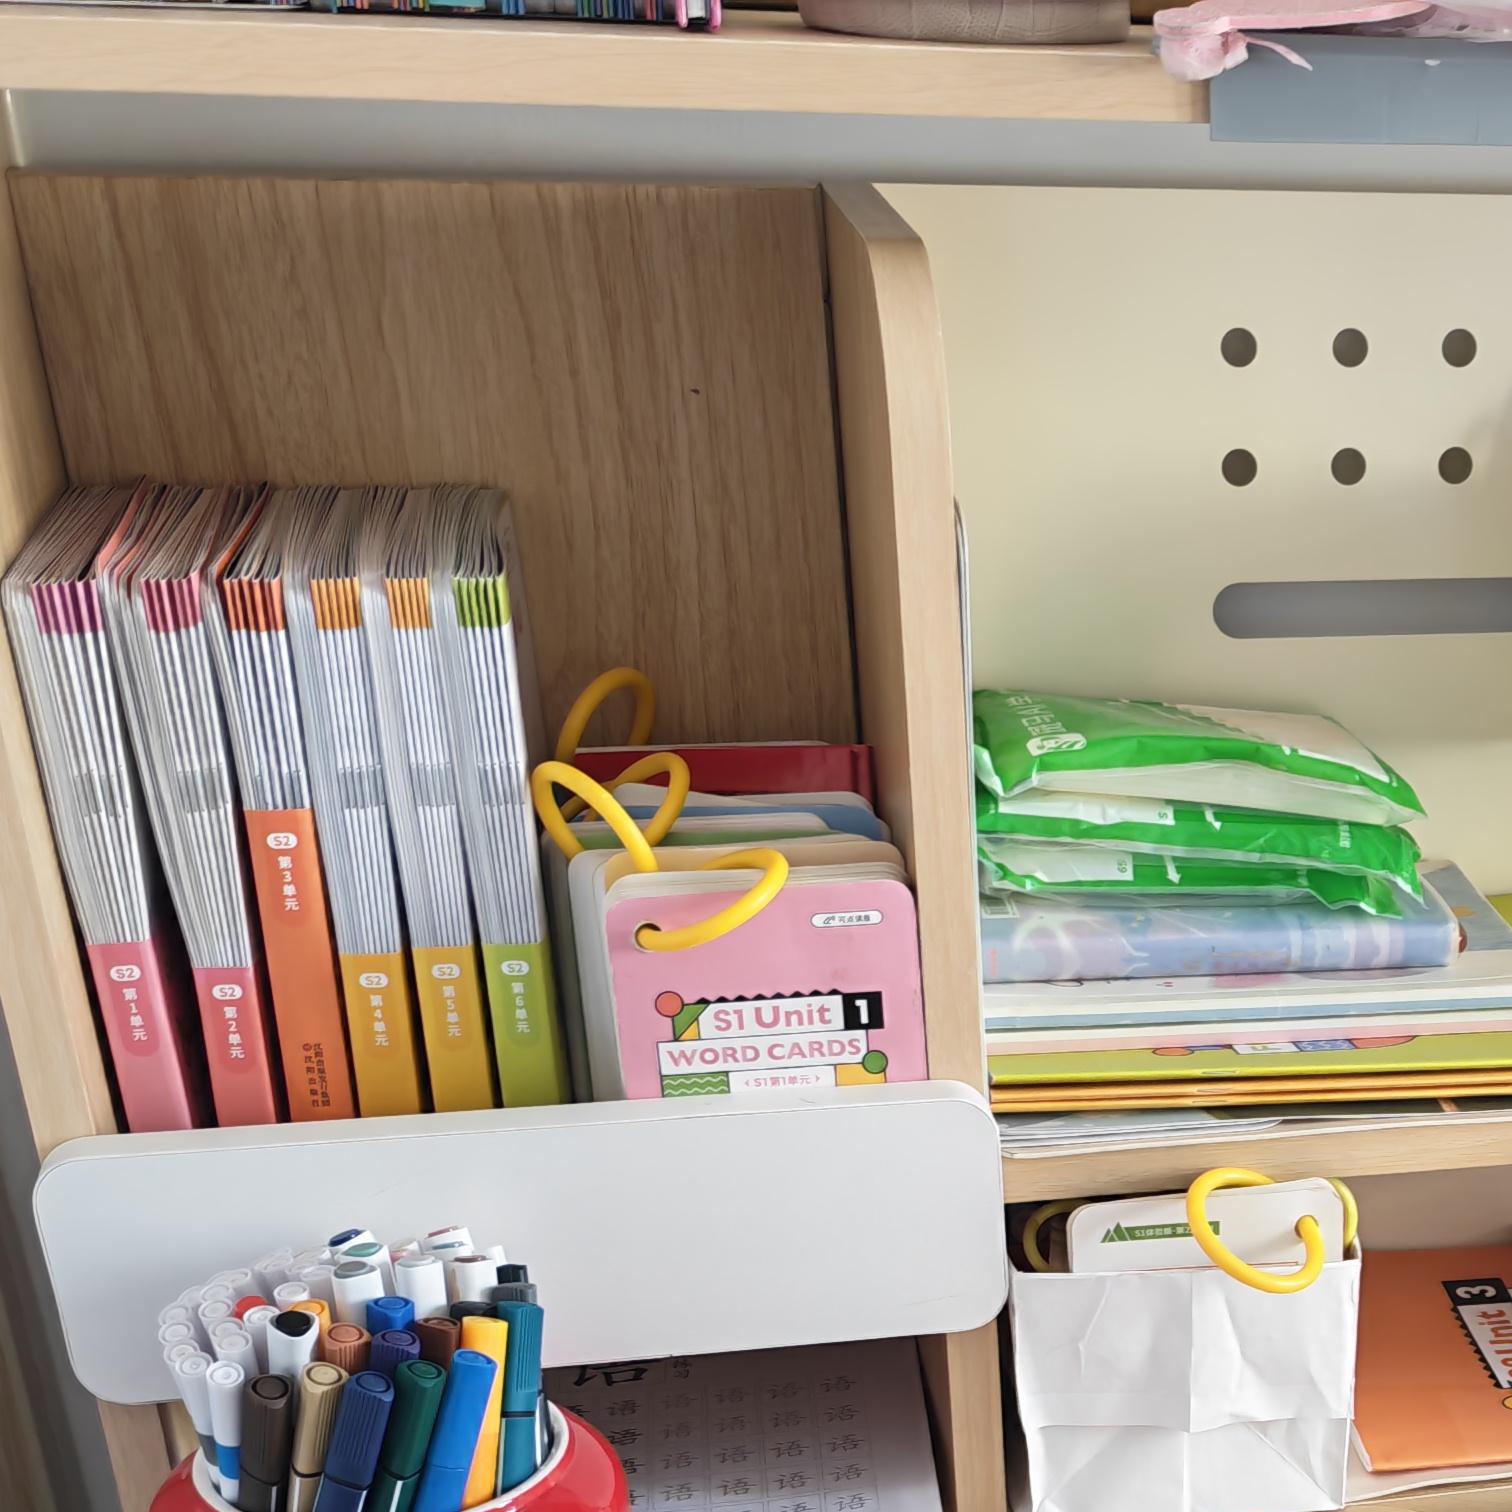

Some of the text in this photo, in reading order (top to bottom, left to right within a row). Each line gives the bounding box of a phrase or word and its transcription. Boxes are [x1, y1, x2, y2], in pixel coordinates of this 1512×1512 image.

[273, 836, 299, 911] S2 第3单元
[115, 967, 148, 1041] S2 第1单元
[219, 987, 245, 1058] S2 第2单元
[365, 976, 389, 1046] S2 第4单元
[437, 967, 461, 1037] S2 第5单元
[507, 963, 530, 1034] S2 第6单元
[713, 999, 869, 1032] S1 Unit 1
[667, 1038, 861, 1067] WORD CARDS
[1456, 1284, 1497, 1299] 3
[660, 1464, 868, 1501] 语 语 语 语
[835, 1493, 871, 1511] 语
